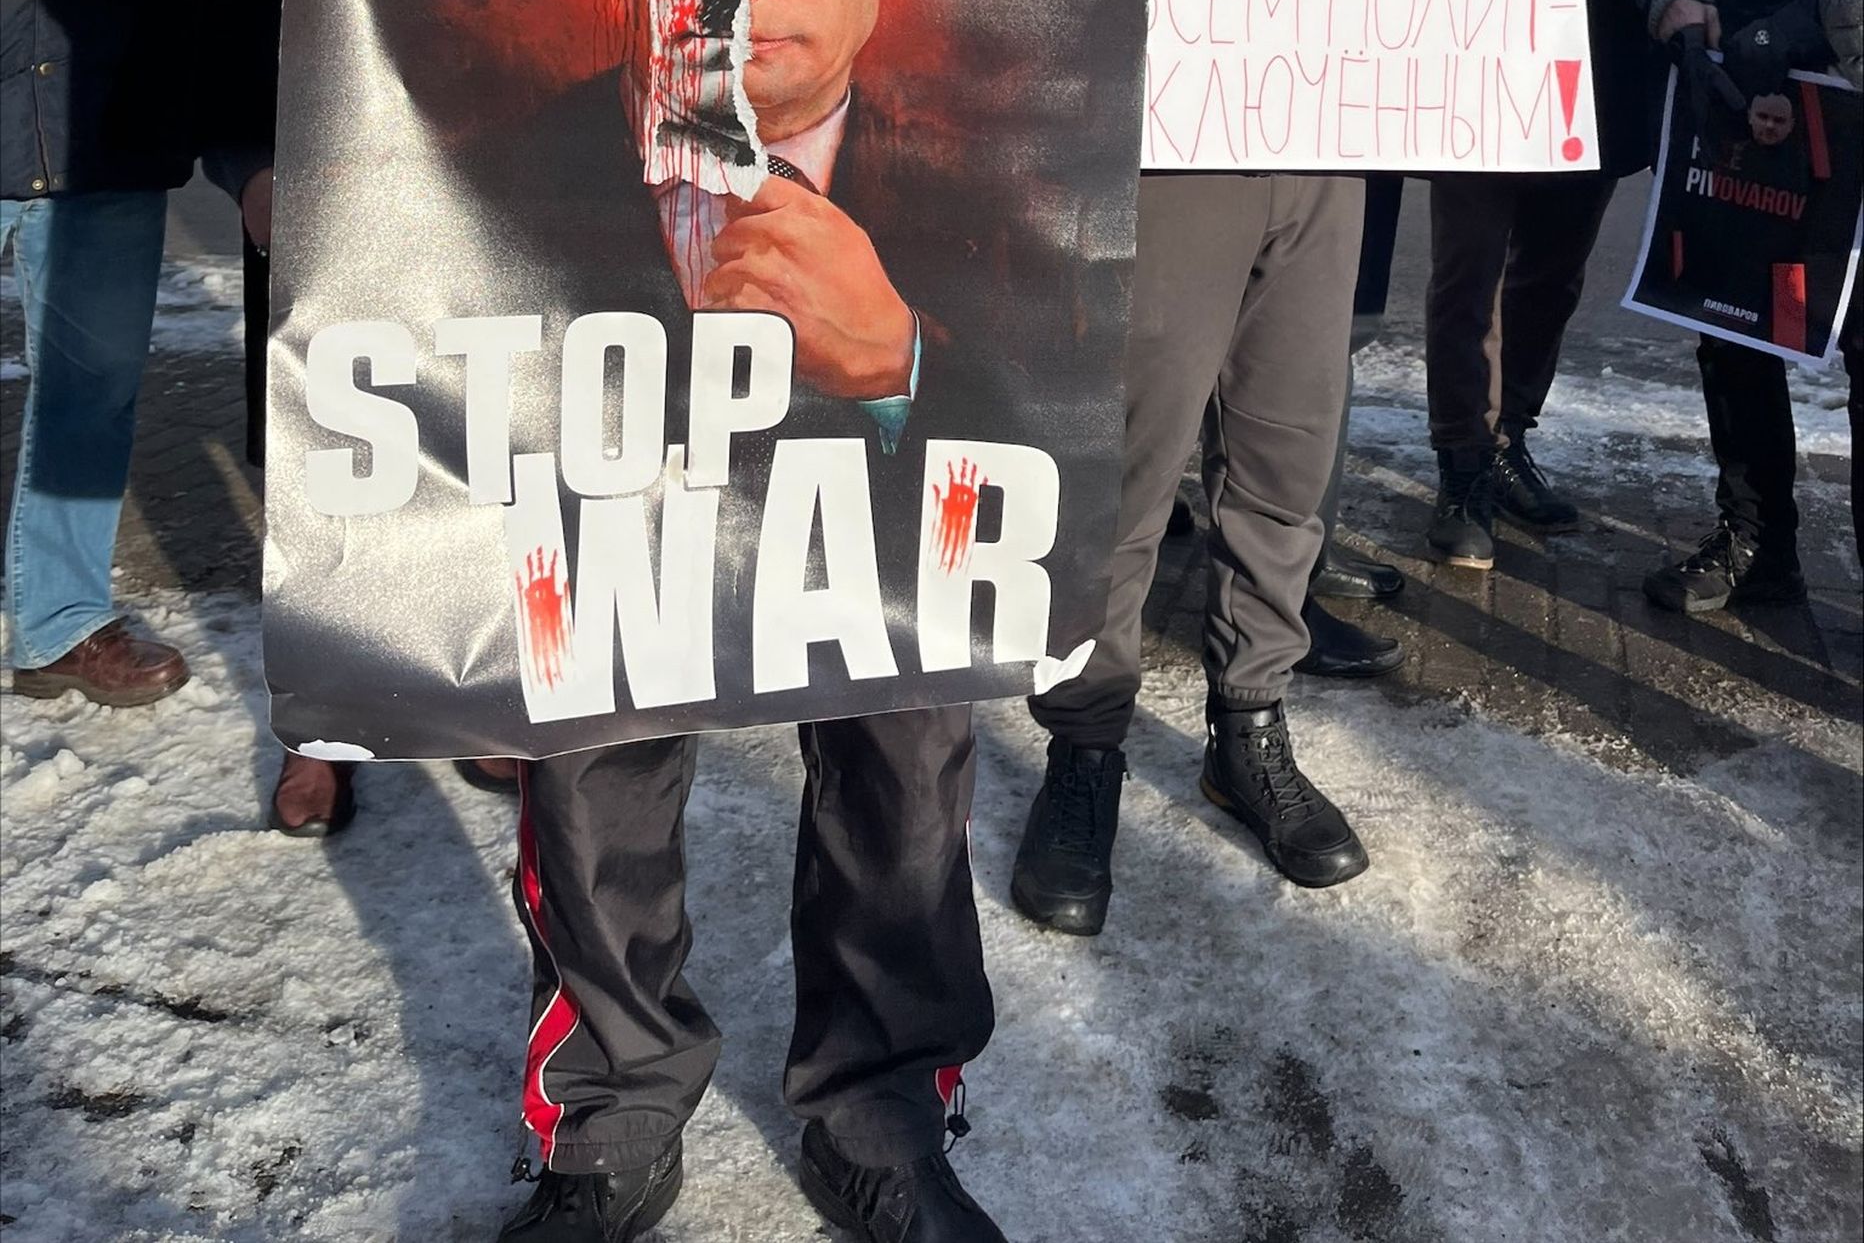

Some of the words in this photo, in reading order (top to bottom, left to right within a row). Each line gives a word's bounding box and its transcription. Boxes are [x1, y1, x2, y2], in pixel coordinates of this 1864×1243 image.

[1685, 166, 1808, 220] PIVOVAROV
[304, 312, 796, 518] STOP
[501, 438, 1062, 725] WAR
